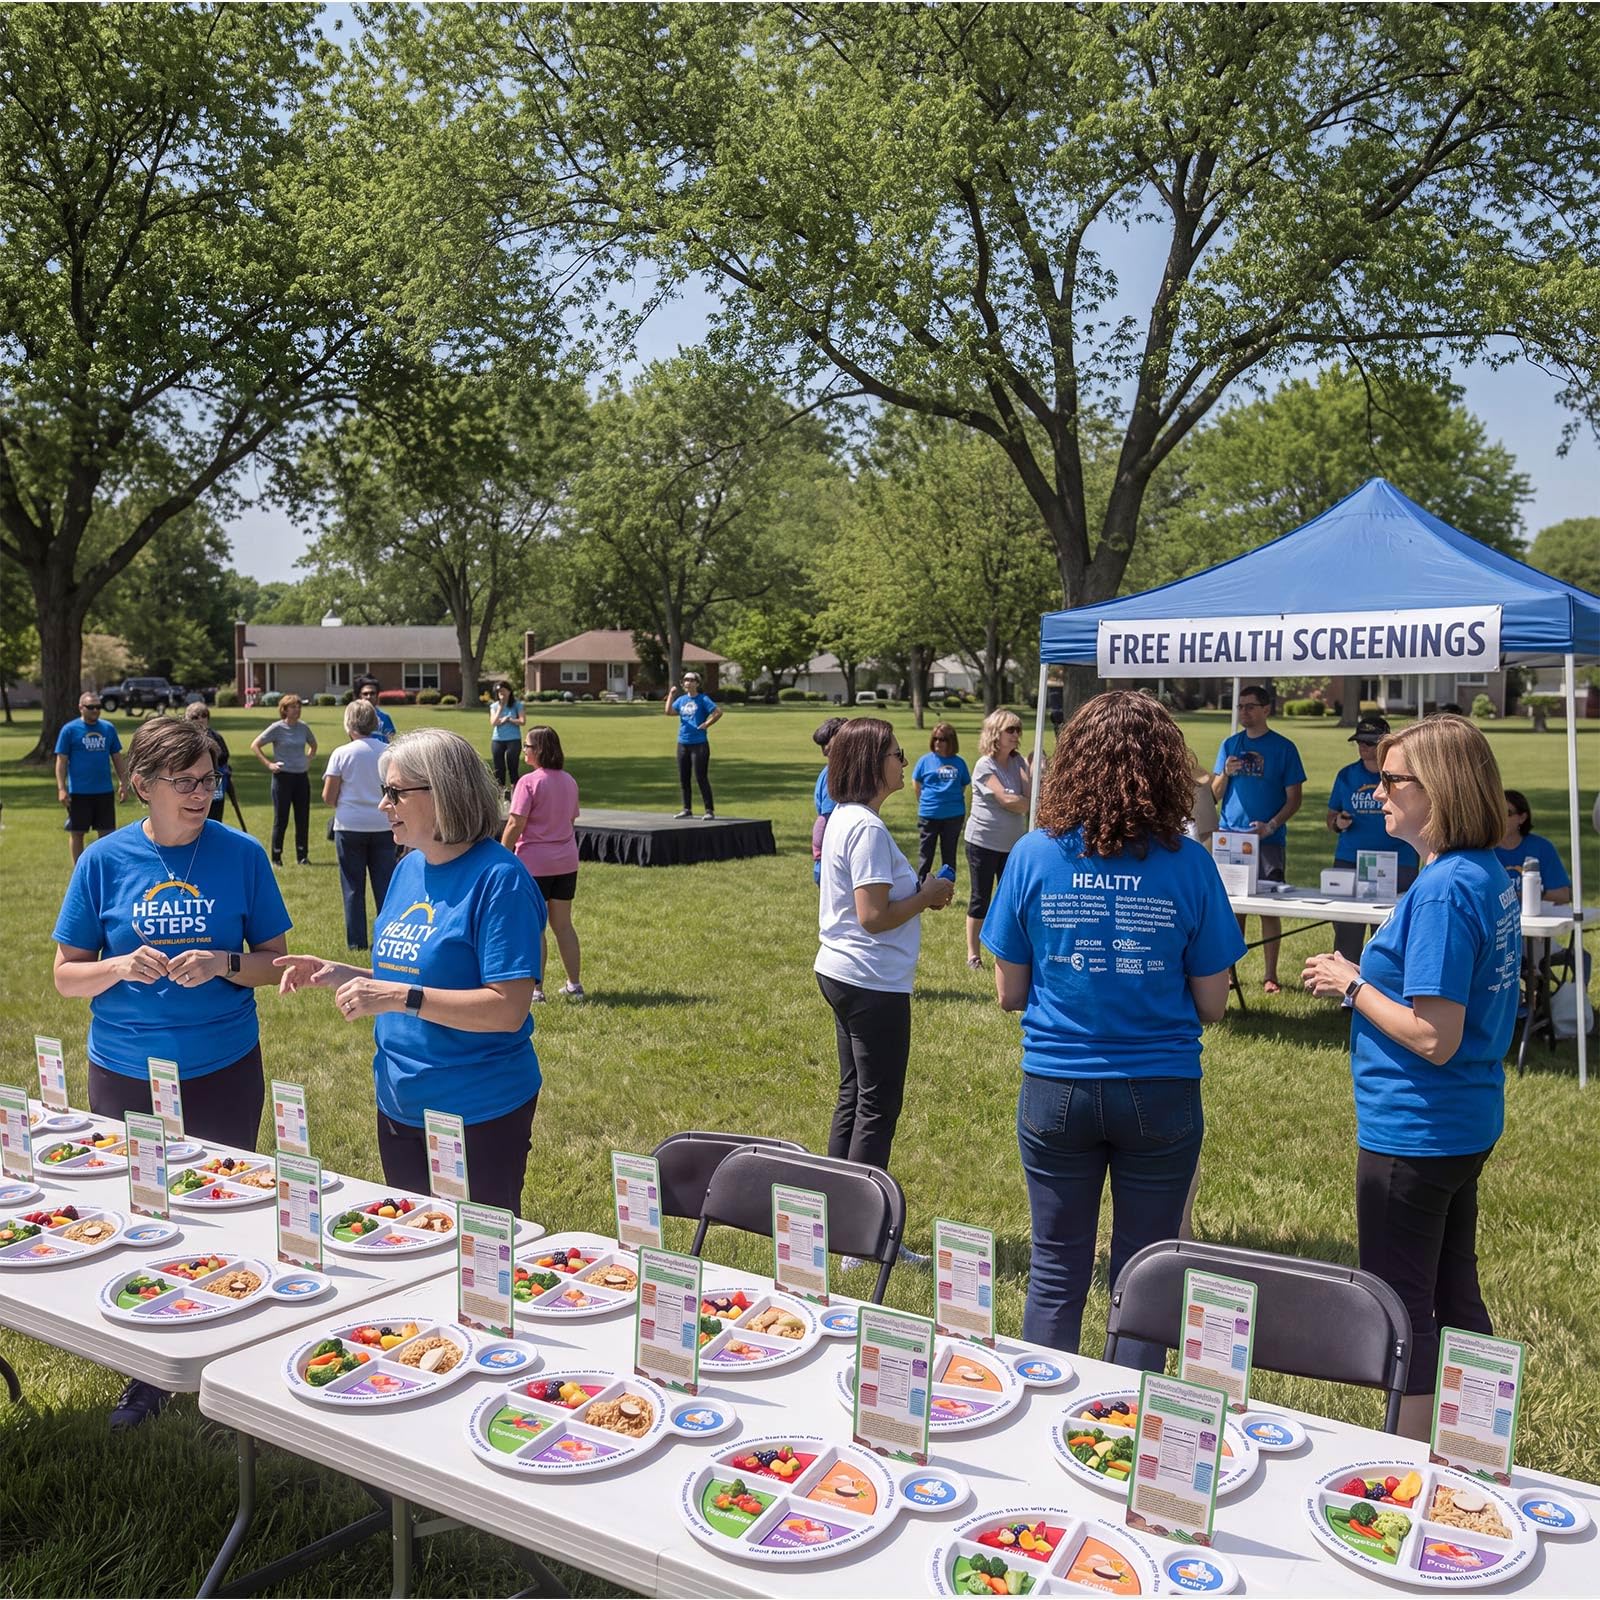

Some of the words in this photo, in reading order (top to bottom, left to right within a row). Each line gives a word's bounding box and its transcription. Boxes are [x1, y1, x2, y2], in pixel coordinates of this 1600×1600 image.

[1109, 631, 1170, 664] FREE
[1179, 629, 1284, 663] HEALTH
[1292, 621, 1486, 661] SCREENINGS
[1072, 873, 1142, 891] HEALTTY
[132, 899, 216, 917] HEALTTY
[143, 916, 207, 935] STEPS
[381, 921, 438, 942] HEALTY
[377, 939, 421, 961] STEPS
[911, 1493, 938, 1506] Dairy
[1426, 1558, 1467, 1573] Protein
[1180, 1577, 1207, 1591] Dairy
